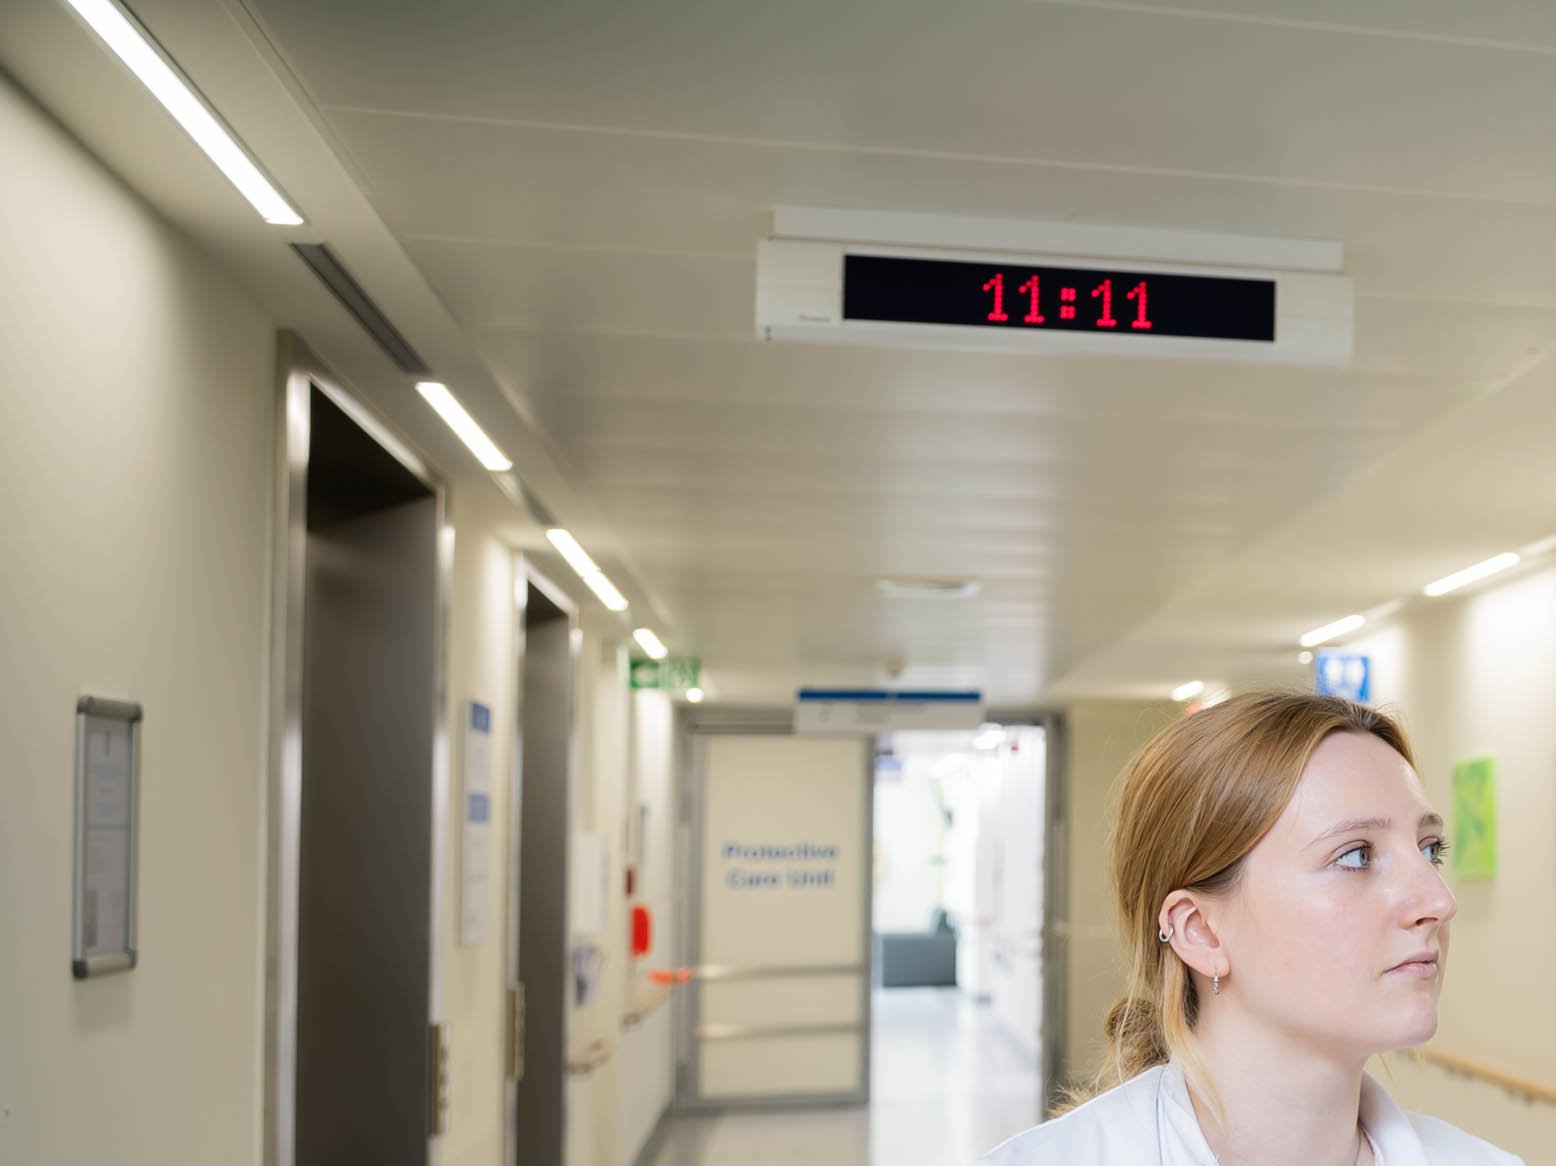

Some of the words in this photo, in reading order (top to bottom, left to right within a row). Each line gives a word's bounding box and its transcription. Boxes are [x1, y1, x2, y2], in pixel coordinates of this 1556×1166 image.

[983, 274, 1152, 329] 11:11
[722, 841, 838, 860] Protective
[726, 868, 779, 889] Care
